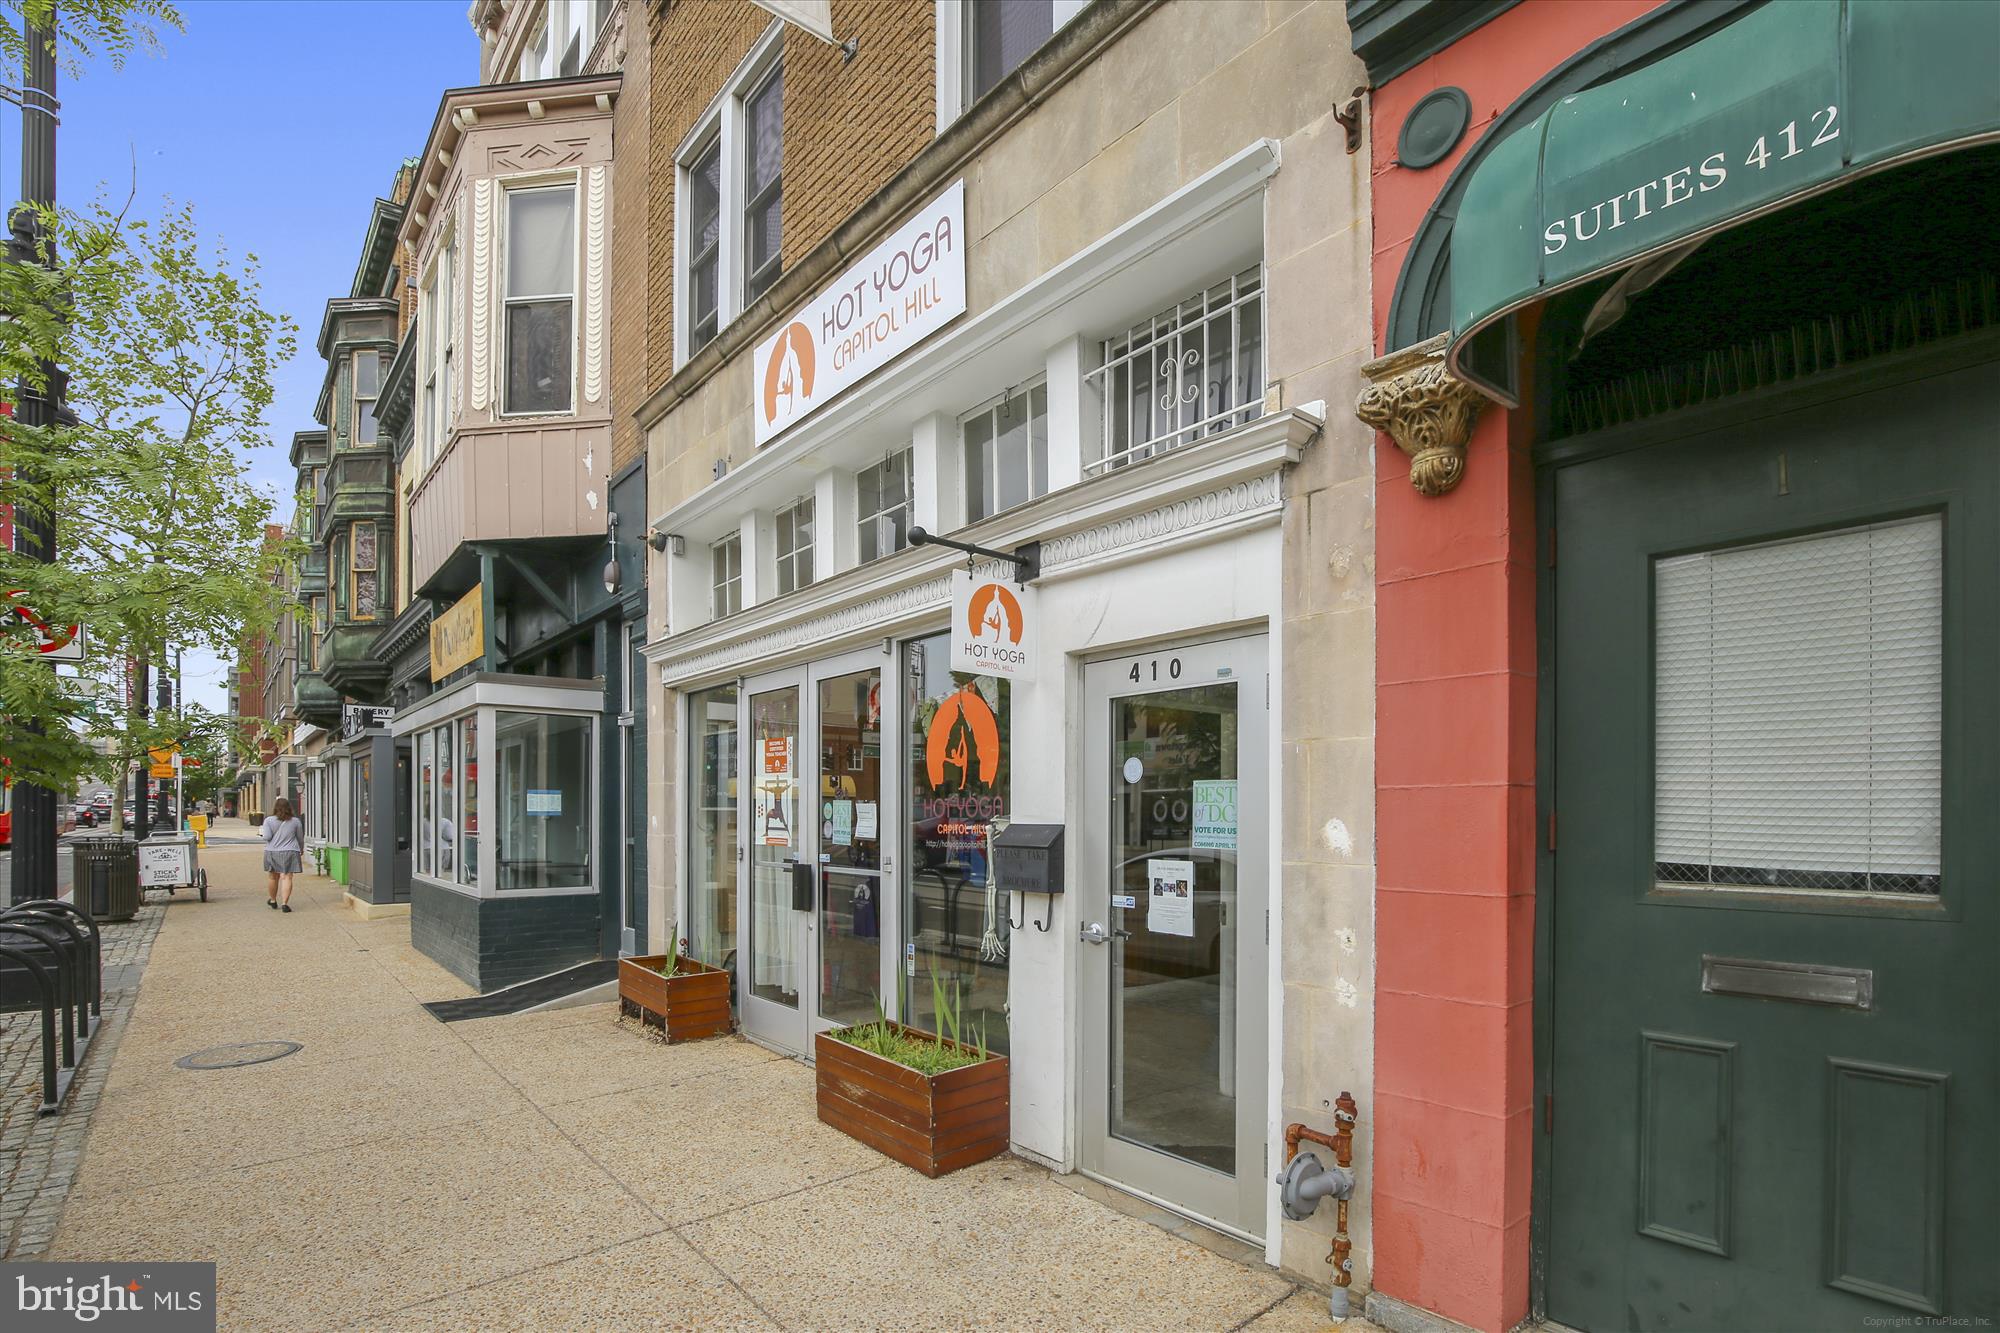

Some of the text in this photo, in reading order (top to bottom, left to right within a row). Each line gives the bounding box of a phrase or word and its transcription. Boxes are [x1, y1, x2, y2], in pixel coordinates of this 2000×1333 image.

[1544, 105, 1840, 255] SUITES 412
[823, 215, 951, 344] HOT YOGA
[833, 277, 941, 371] CAPITOL HILL
[964, 643, 1025, 664] HOT YOGA
[976, 660, 1001, 671] CAPITOL
[1129, 658, 1181, 682] 410
[1194, 787, 1237, 803] BEST
[924, 796, 1004, 817] HOT YOGA
[1195, 805, 1207, 821] of
[937, 823, 988, 835] CAPITOL HILL
[1194, 826, 1211, 834] VOTE
[996, 849, 1047, 860] PLEASE TAKE
